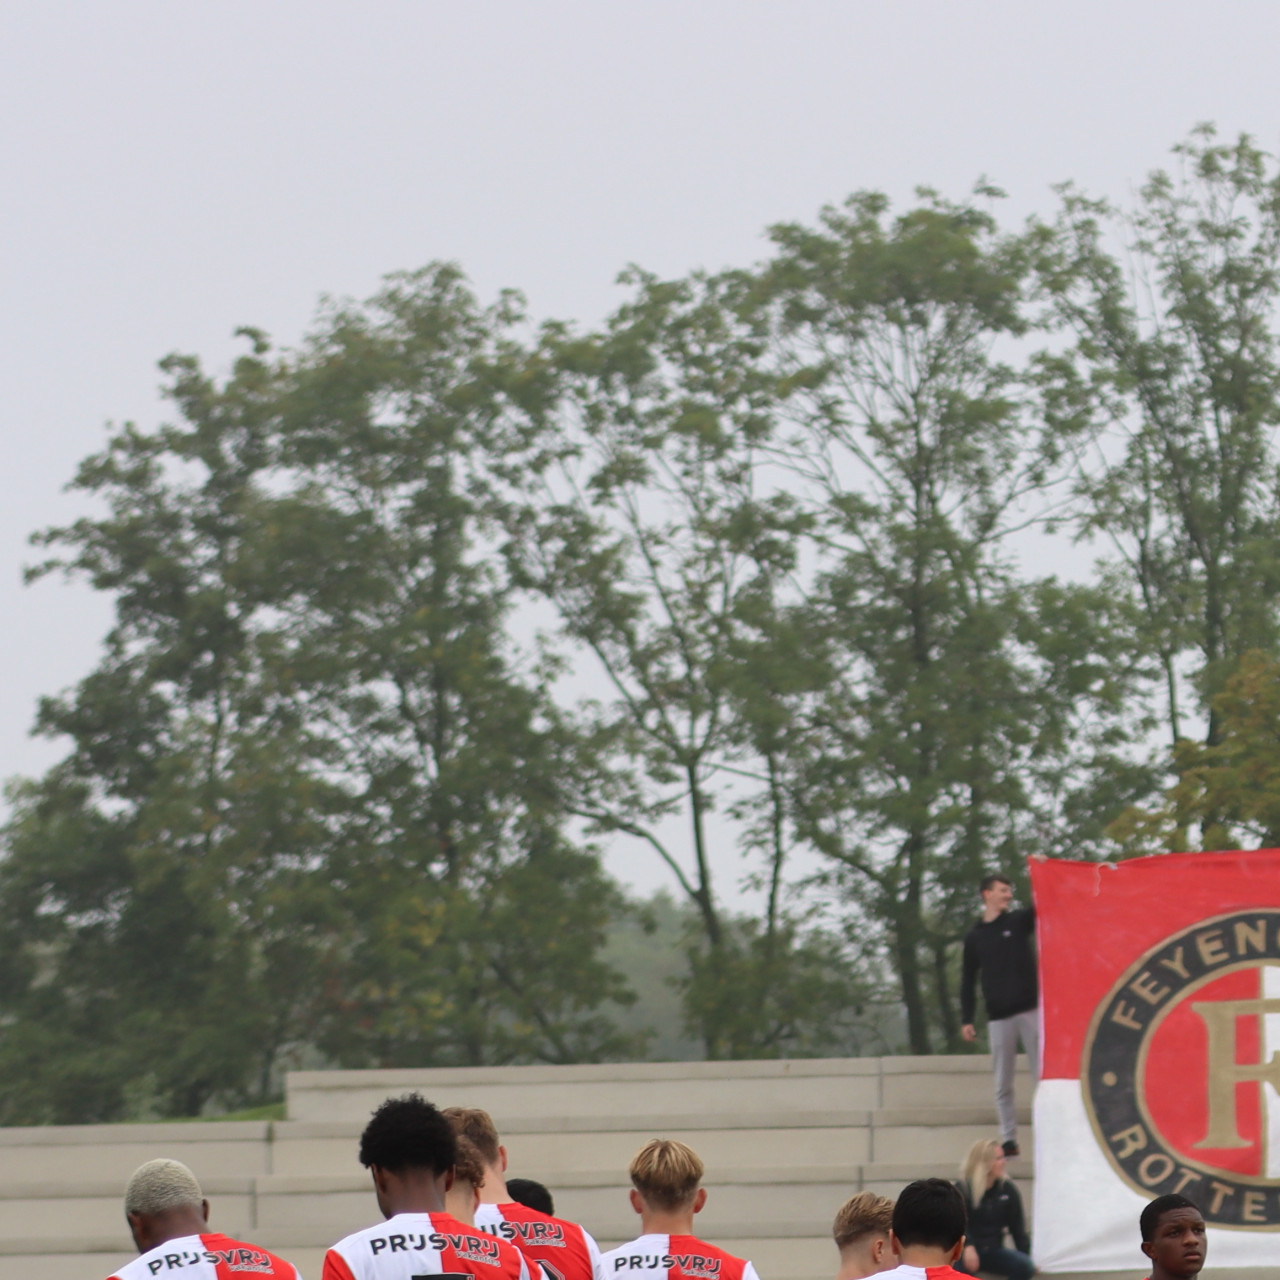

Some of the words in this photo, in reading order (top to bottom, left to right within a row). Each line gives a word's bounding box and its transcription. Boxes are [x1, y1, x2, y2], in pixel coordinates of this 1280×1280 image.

[370, 1233, 500, 1258] PRIJSVRIJ
[147, 1248, 271, 1276] PRIJSVRIJ
[614, 1254, 721, 1273] PRIJSVRIJ
